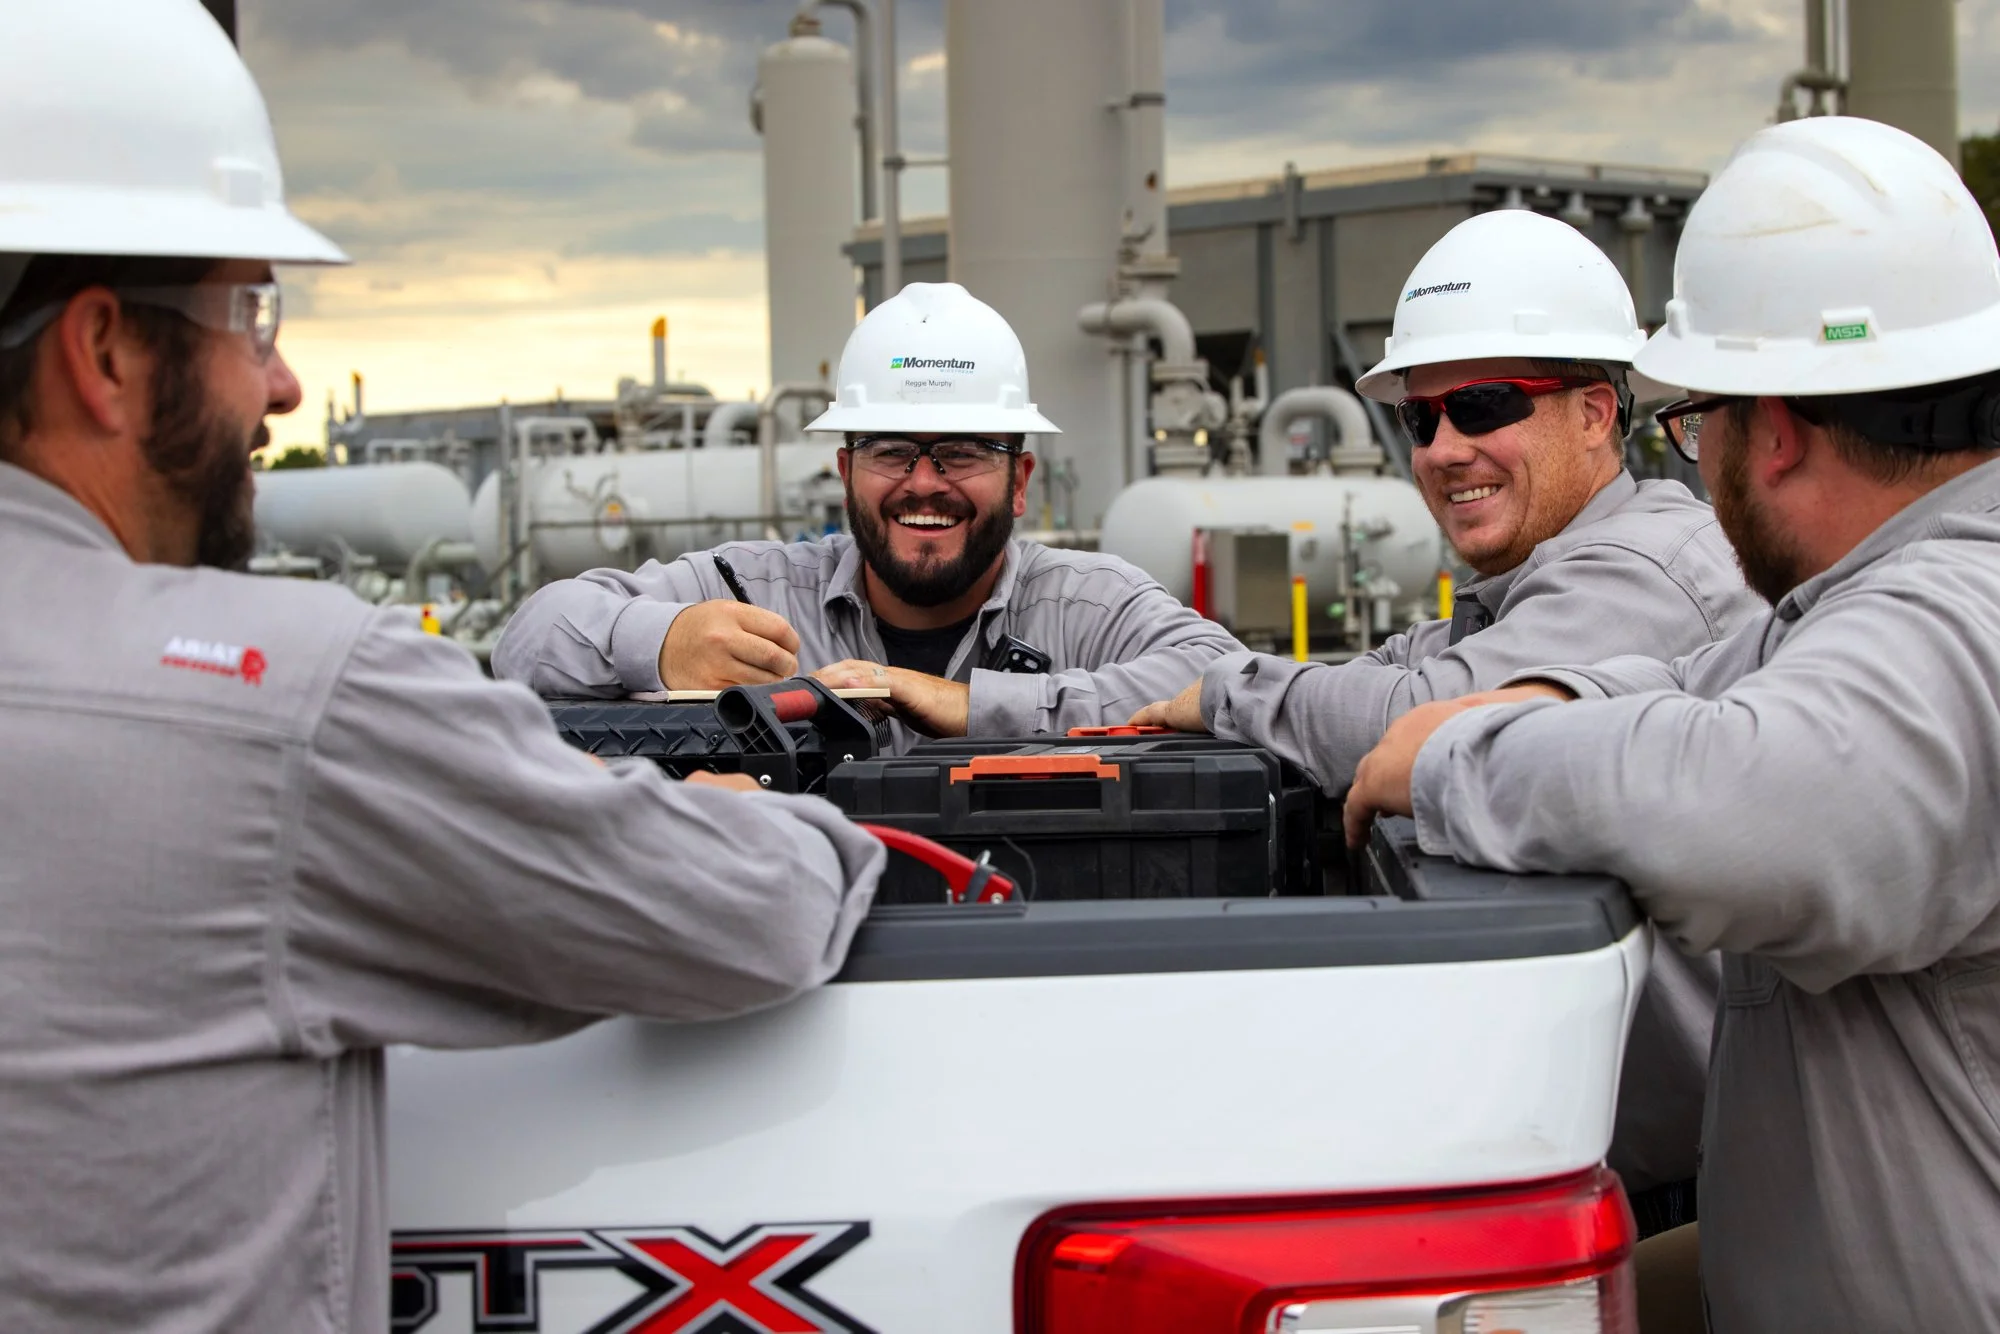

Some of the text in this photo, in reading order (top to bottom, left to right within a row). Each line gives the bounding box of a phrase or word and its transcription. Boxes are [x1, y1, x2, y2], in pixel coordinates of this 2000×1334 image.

[1411, 281, 1471, 299] Momentum
[1828, 326, 1865, 338] MSA
[903, 357, 975, 369] Momentum
[905, 380, 952, 388] Reggie Murphy
